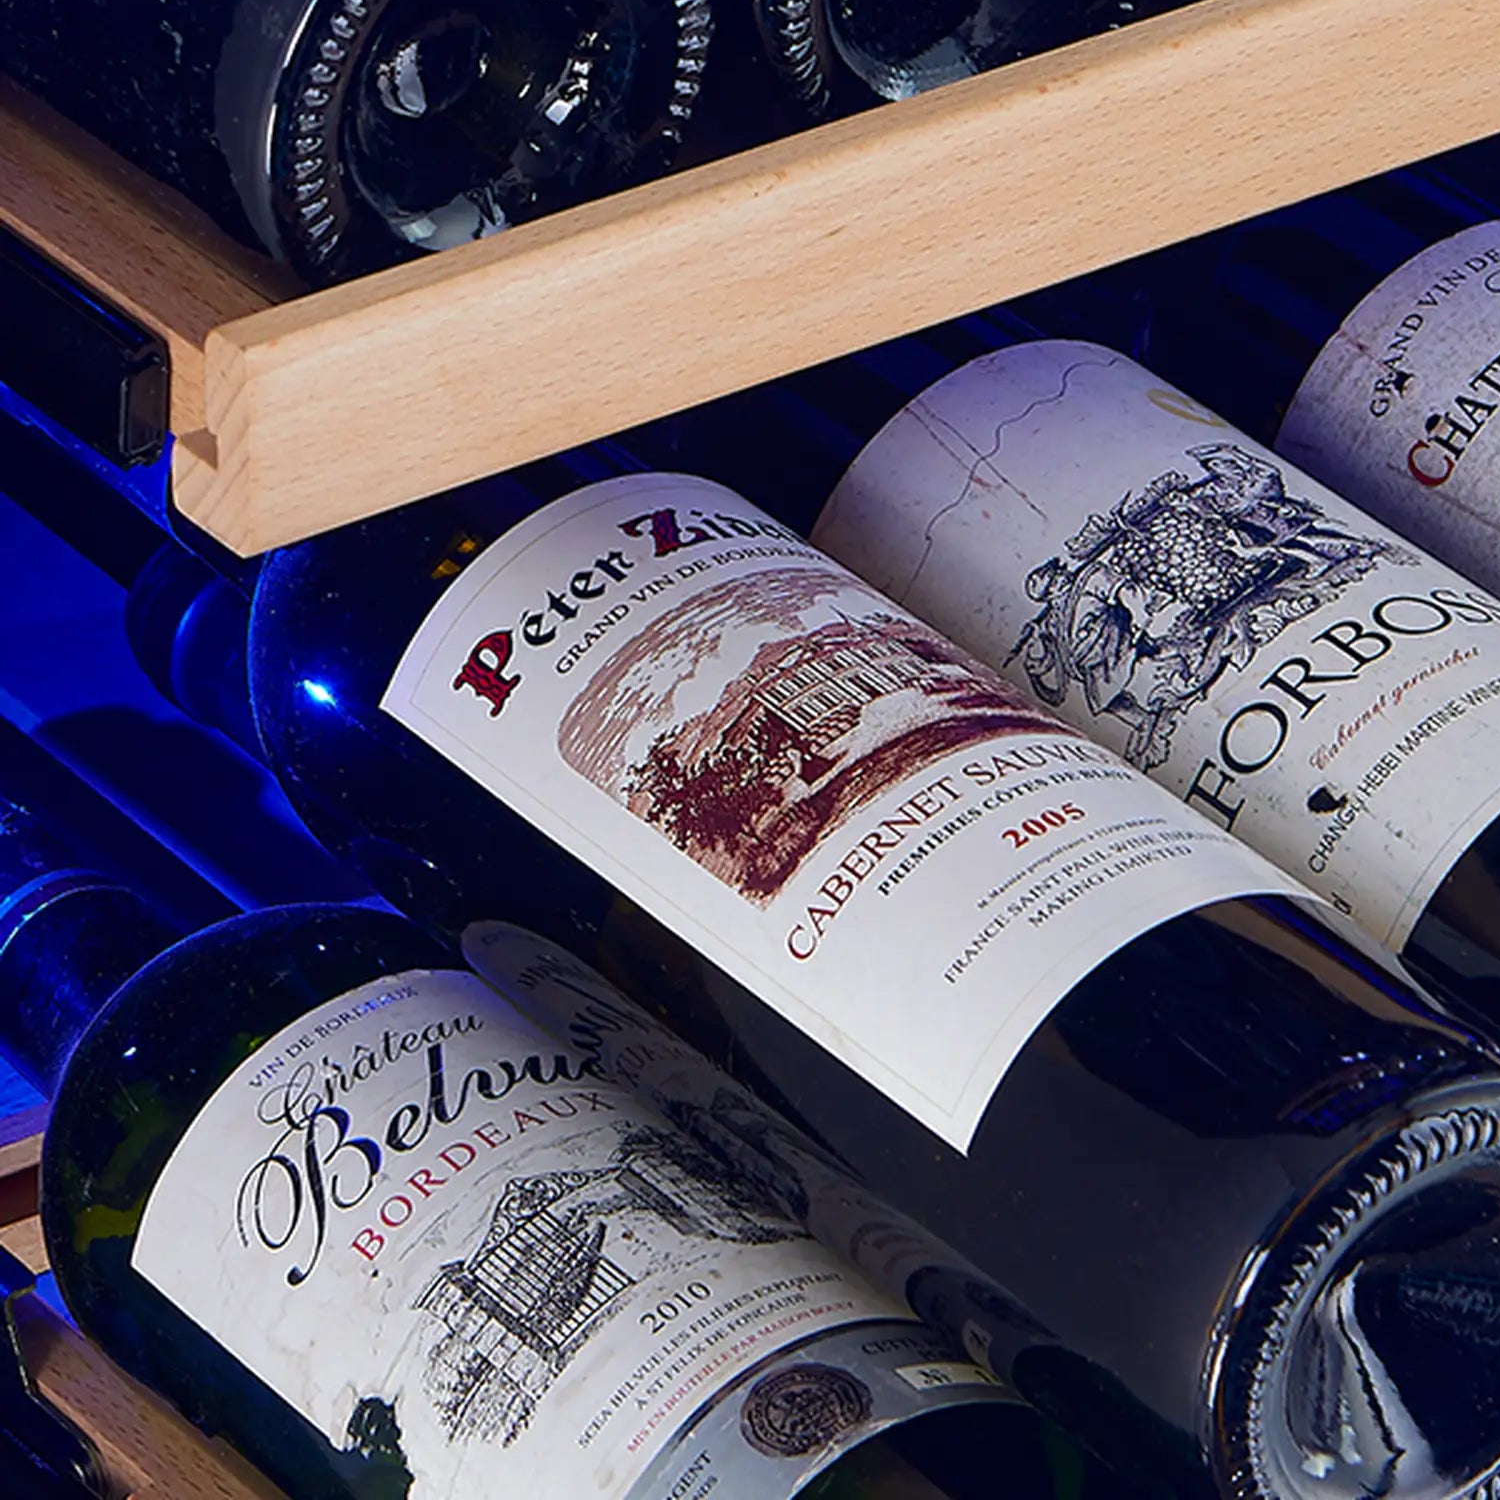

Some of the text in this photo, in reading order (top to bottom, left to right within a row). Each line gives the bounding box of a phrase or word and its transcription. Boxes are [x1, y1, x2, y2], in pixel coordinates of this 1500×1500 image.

[1369, 313, 1424, 418] GRAND
[1416, 268, 1467, 309] VIN
[555, 557, 712, 676] GRAND VIN DE
[1049, 768, 1081, 786] DE
[1308, 692, 1387, 771] Cabernet
[1357, 752, 1403, 798] HEBEI
[1396, 700, 1467, 757] MARTINE
[784, 775, 964, 962] CABERNET
[1000, 800, 1087, 850] 2005
[944, 913, 1008, 984] FRANCE
[1005, 872, 1062, 917] SAINT
[1061, 850, 1114, 880] PAUL
[1025, 875, 1107, 929] MAKING
[248, 984, 420, 1090] VIN DE BORDEAUX
[351, 1090, 617, 1262] BORDEAUX
[640, 1282, 713, 1335] 2010
[661, 1332, 691, 1356] LES
[627, 1432, 648, 1453] MIS
[647, 1409, 666, 1434] EN
[664, 1353, 733, 1411] BOUTEILLE
[731, 1336, 758, 1356] PAR
[648, 1376, 668, 1399] ST
[665, 1345, 707, 1381] FELIX
[705, 1328, 729, 1349] DE
